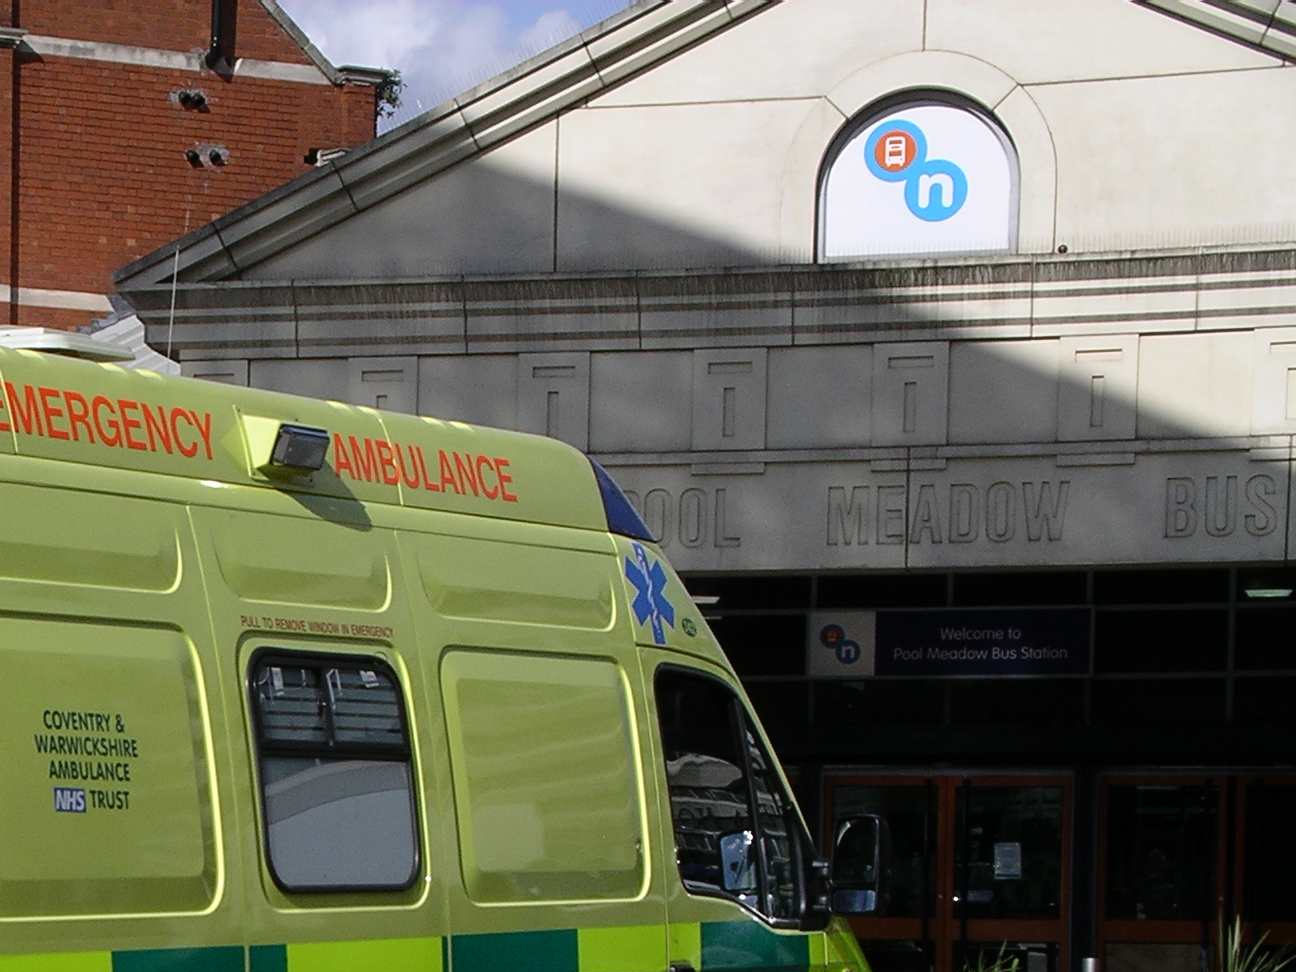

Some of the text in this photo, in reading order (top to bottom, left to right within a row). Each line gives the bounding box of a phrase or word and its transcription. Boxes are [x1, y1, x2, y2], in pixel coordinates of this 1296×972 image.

[918, 173, 954, 208] n
[333, 433, 518, 503] AMBULANCE
[826, 480, 1070, 547] MEADOW
[1164, 474, 1278, 540] BUS
[240, 615, 394, 638] PULL TO REMOVE WINDOW IN EMERGENCY
[940, 626, 1022, 640] Welcome to
[893, 646, 1069, 661] Pool Meadow Bus Station
[43, 709, 125, 733] COVENTRY &
[34, 734, 139, 758] WARWICKSHIRE
[49, 760, 131, 782] AMBULANCE
[55, 789, 130, 812] NHS TRUST
